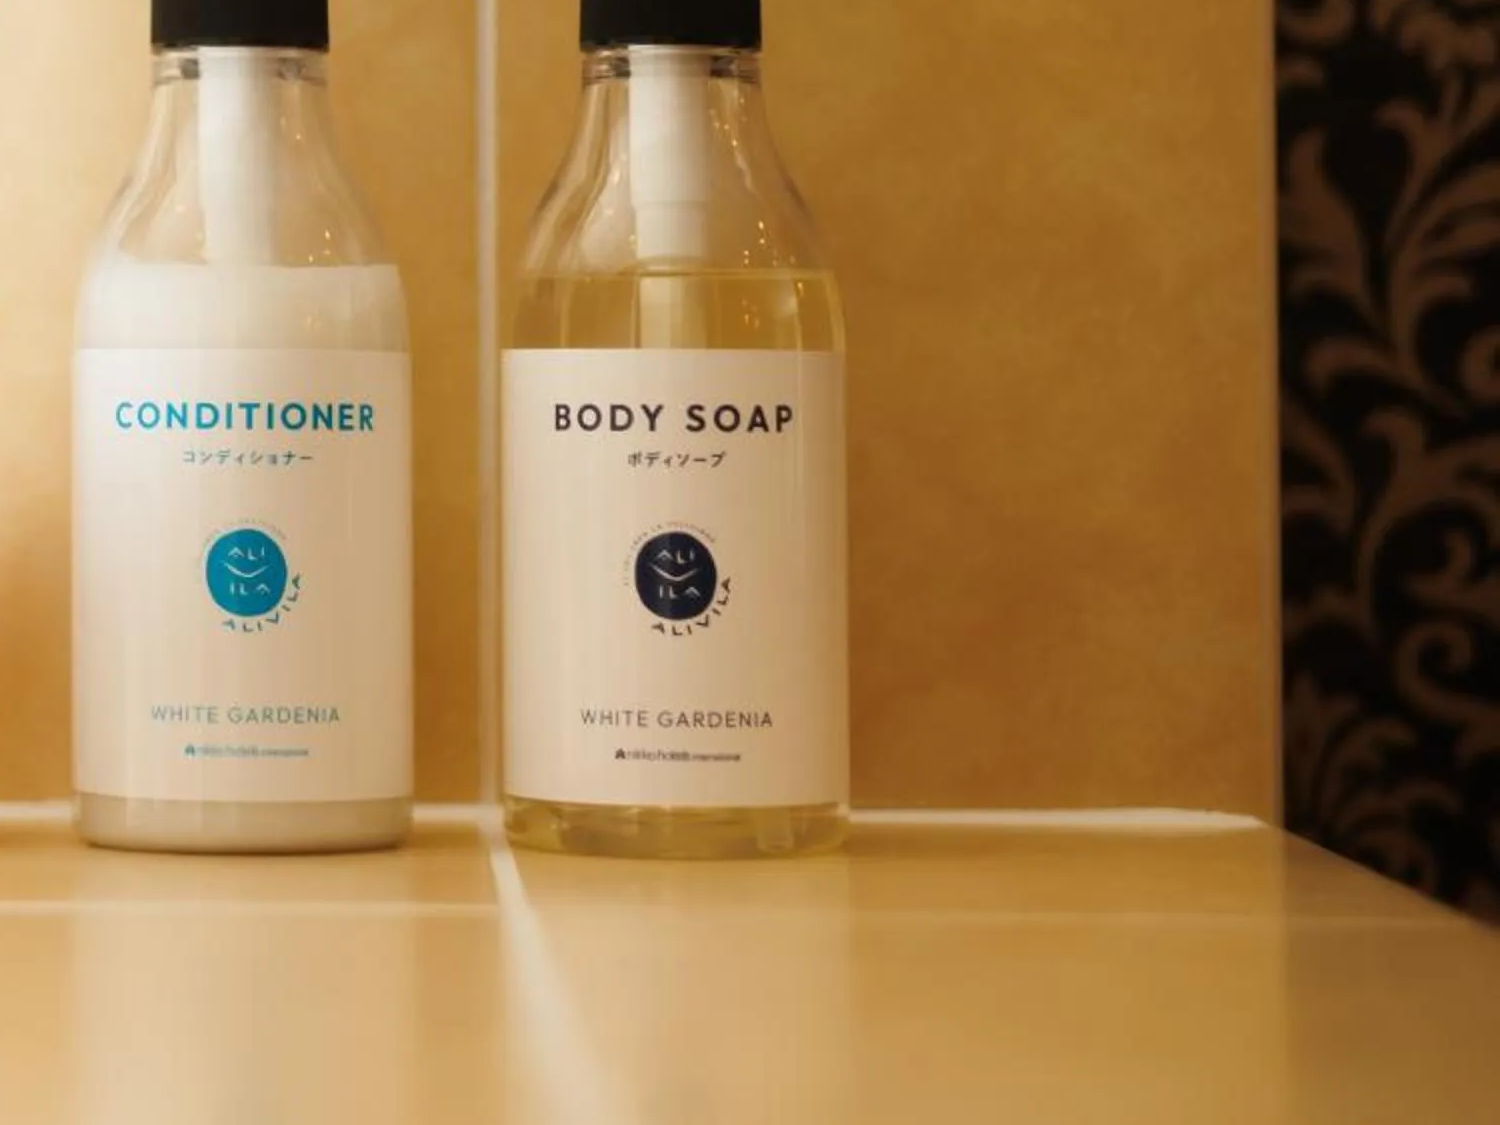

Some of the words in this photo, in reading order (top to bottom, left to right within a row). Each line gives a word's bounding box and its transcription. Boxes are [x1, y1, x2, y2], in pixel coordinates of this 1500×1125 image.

[115, 401, 374, 431] CONDITIONER
[554, 403, 665, 433] BODY
[685, 404, 794, 433] SOAP
[182, 449, 315, 466] コンディショナー
[627, 450, 727, 468] ボディソープ
[221, 573, 301, 633] ALIVILA
[651, 577, 731, 637] ALIVILA
[151, 704, 219, 723] WHITE
[227, 706, 340, 724] GARDENIA
[581, 709, 649, 727] WHITE
[656, 710, 773, 728] GARDENIA
